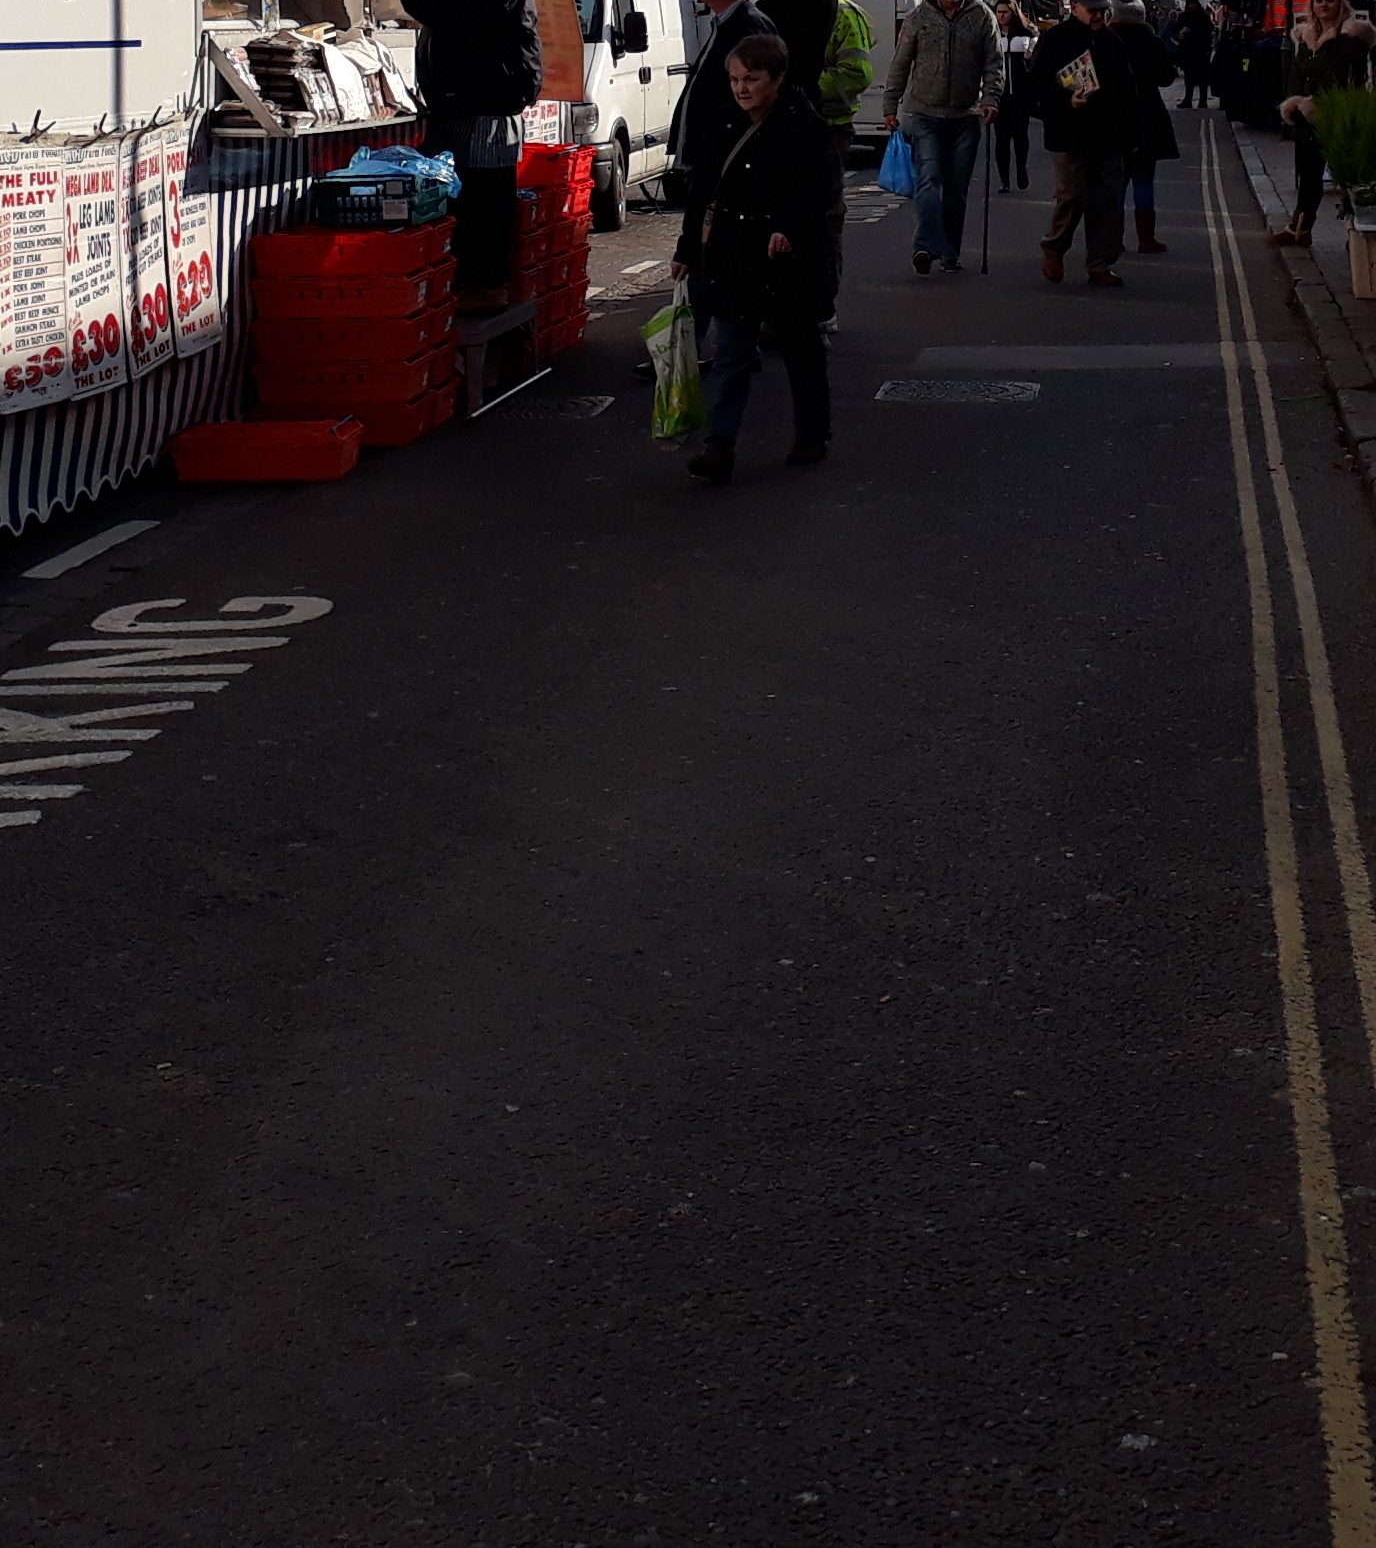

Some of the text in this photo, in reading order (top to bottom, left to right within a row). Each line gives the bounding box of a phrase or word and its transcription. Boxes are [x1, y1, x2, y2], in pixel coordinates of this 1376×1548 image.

[83, 172, 100, 195] LAMB
[1, 189, 56, 208] MEATY
[28, 209, 45, 219] CHOPS
[79, 200, 115, 230] LEG LAMB
[169, 180, 181, 249] 3
[13, 226, 27, 235] LAMB
[29, 224, 46, 233] CHOPS
[87, 232, 111, 261] JOINTS
[85, 263, 103, 278] LOADS
[104, 259, 112, 270] OF
[75, 284, 110, 308] LAMB CHOPS
[177, 251, 213, 322] £20
[14, 297, 28, 307] LAMB
[131, 283, 169, 358] £30
[181, 313, 215, 337] THE LOT
[72, 313, 120, 374] £30
[135, 340, 170, 369] THE LOT
[74, 372, 95, 389] THE
